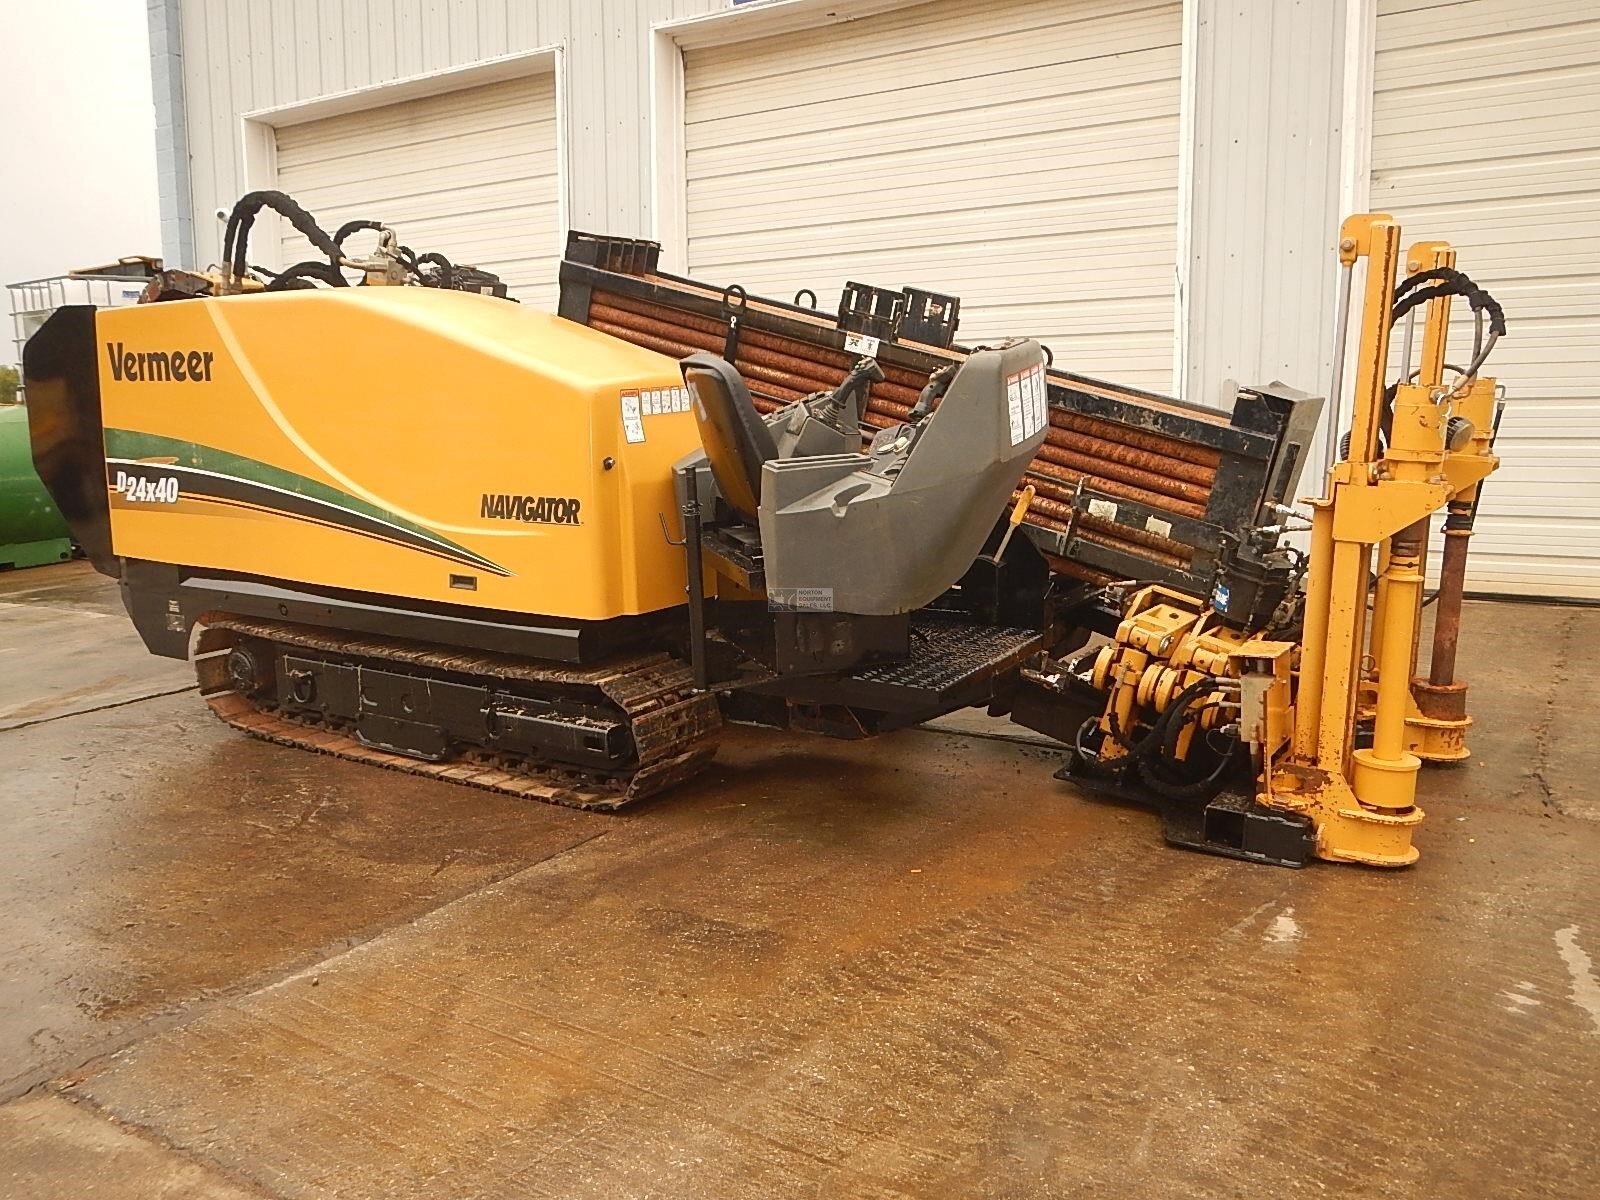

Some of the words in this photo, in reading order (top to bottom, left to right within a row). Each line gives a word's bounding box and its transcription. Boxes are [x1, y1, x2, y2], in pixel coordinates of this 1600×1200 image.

[106, 342, 214, 382] Vermeer
[116, 470, 179, 503] D24x40
[480, 493, 581, 525] NAVIGATOR
